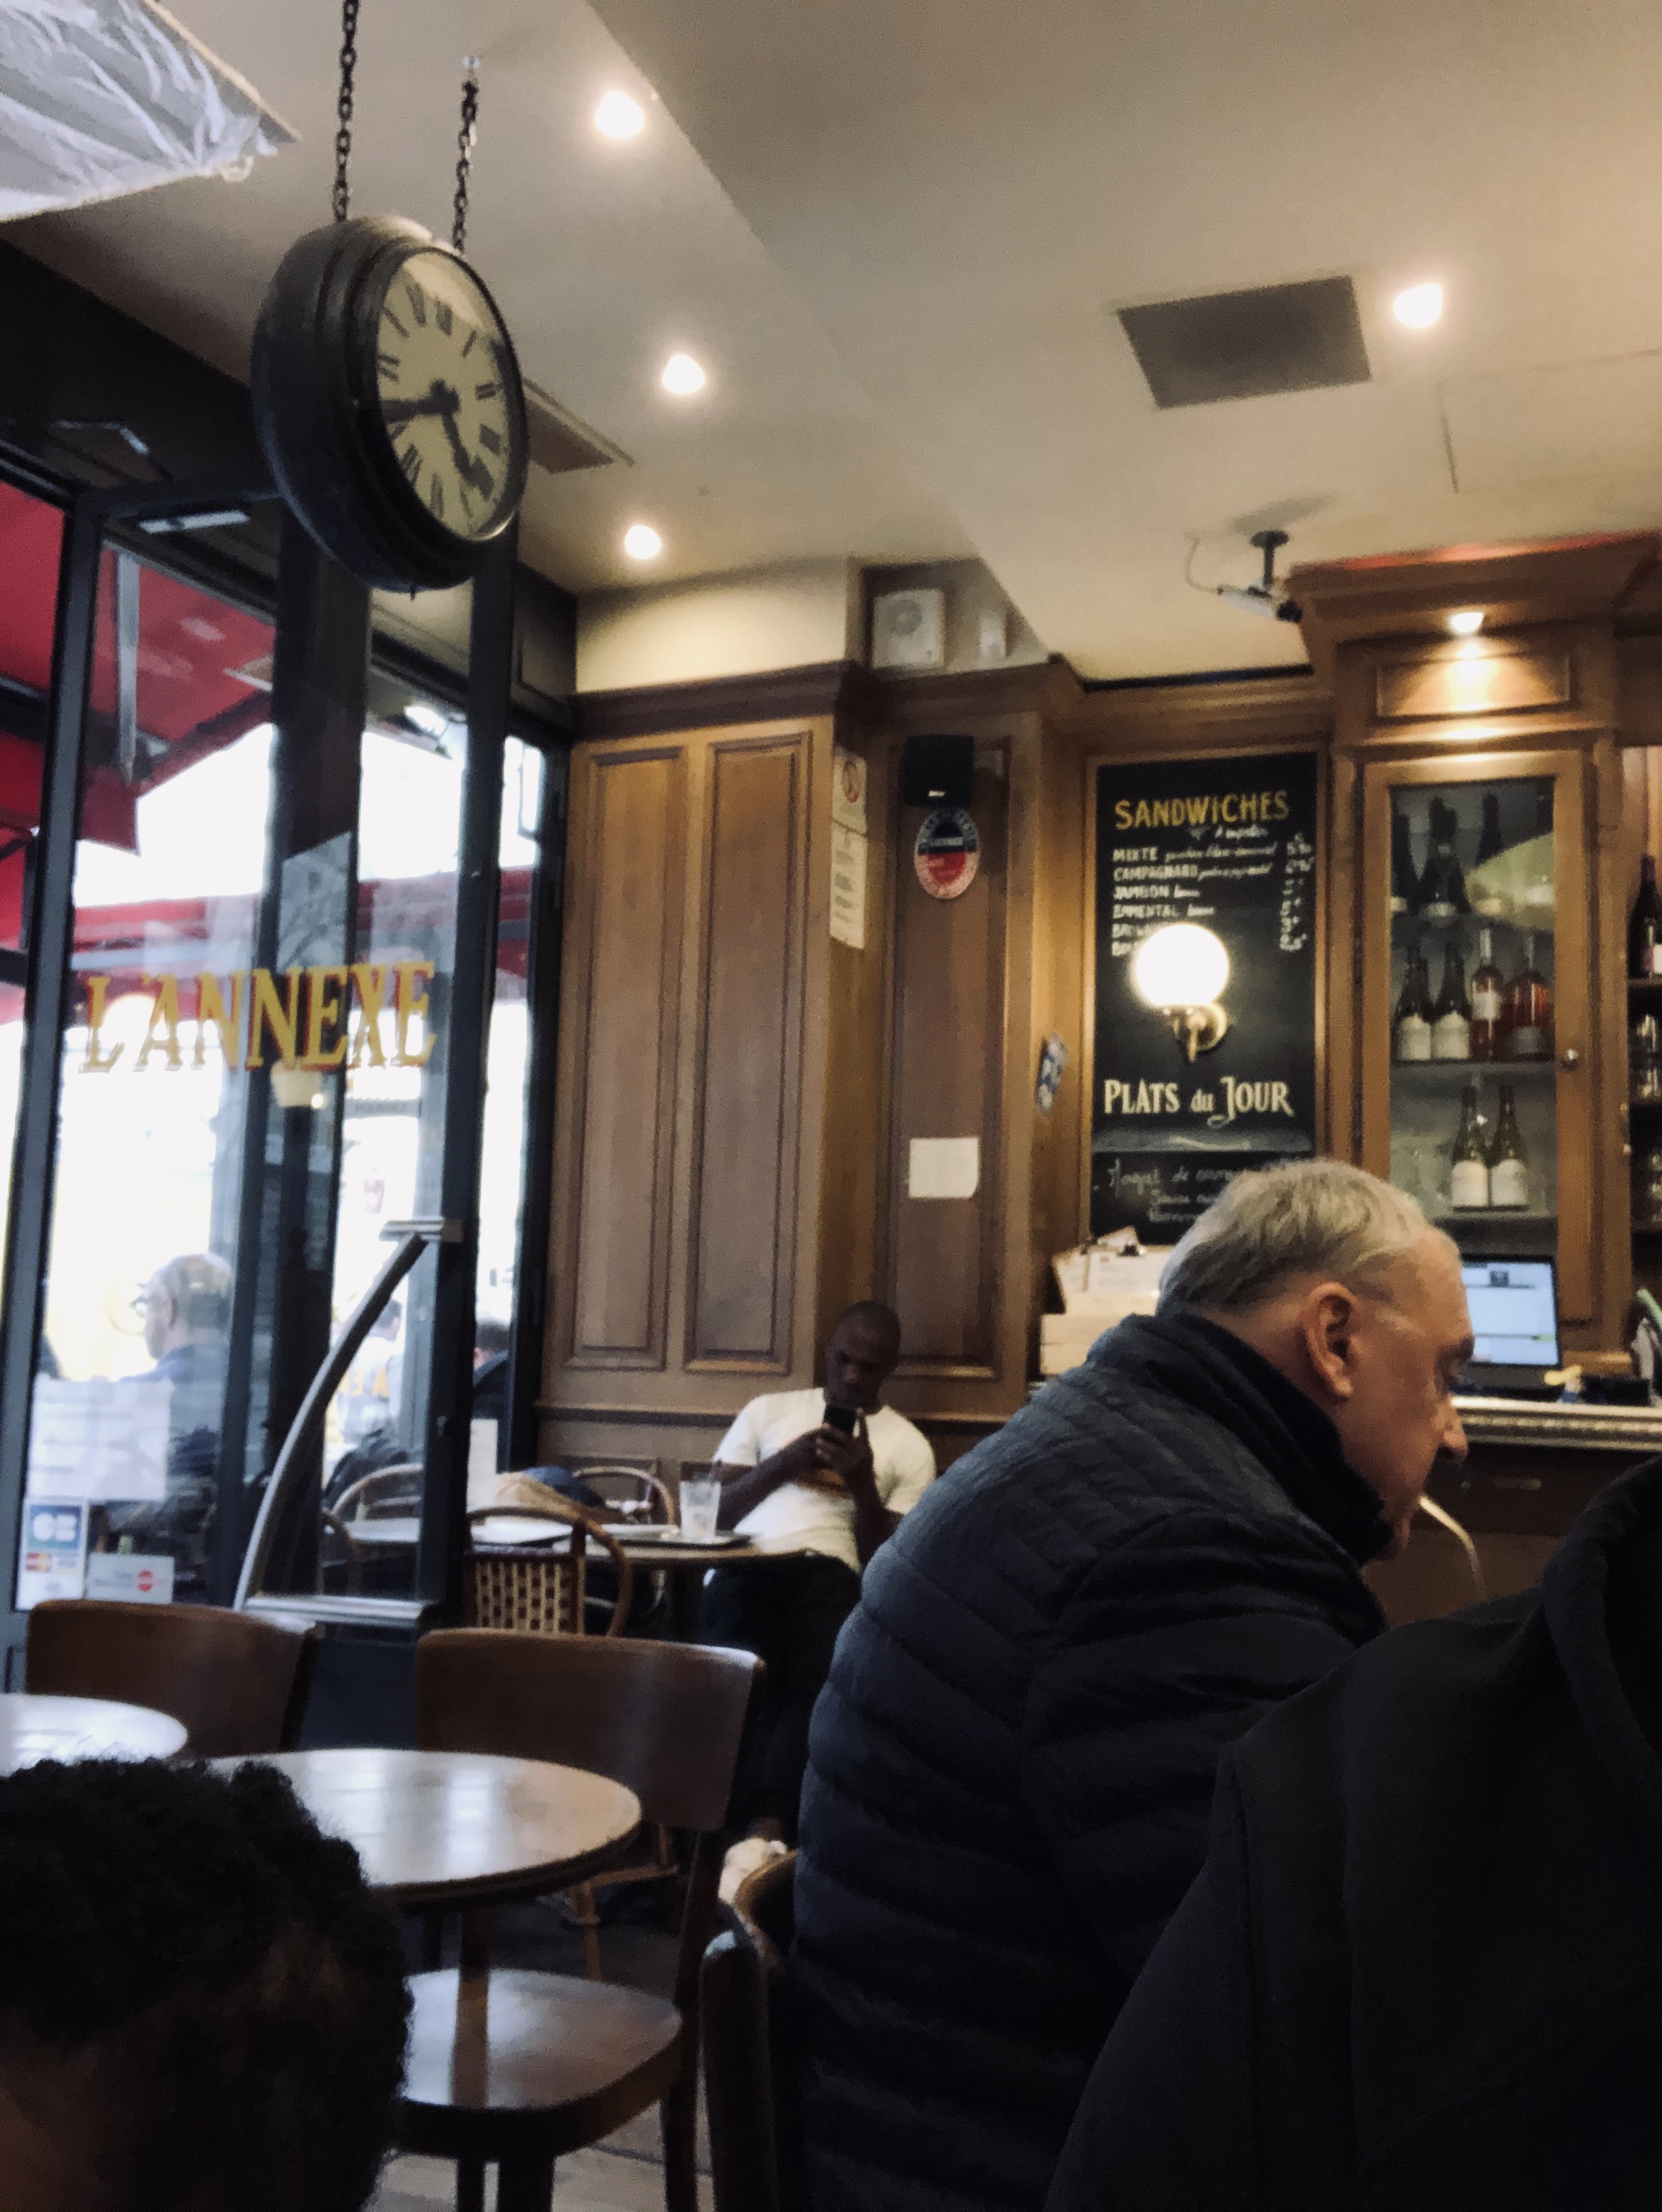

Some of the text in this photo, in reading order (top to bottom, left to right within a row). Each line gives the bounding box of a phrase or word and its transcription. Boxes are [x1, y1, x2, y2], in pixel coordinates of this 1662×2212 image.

[1114, 789, 1289, 831] SANDWICHES
[79, 961, 437, 1073] L'ANNEXE
[1103, 1075, 1294, 1129] PLATS du JOUR
